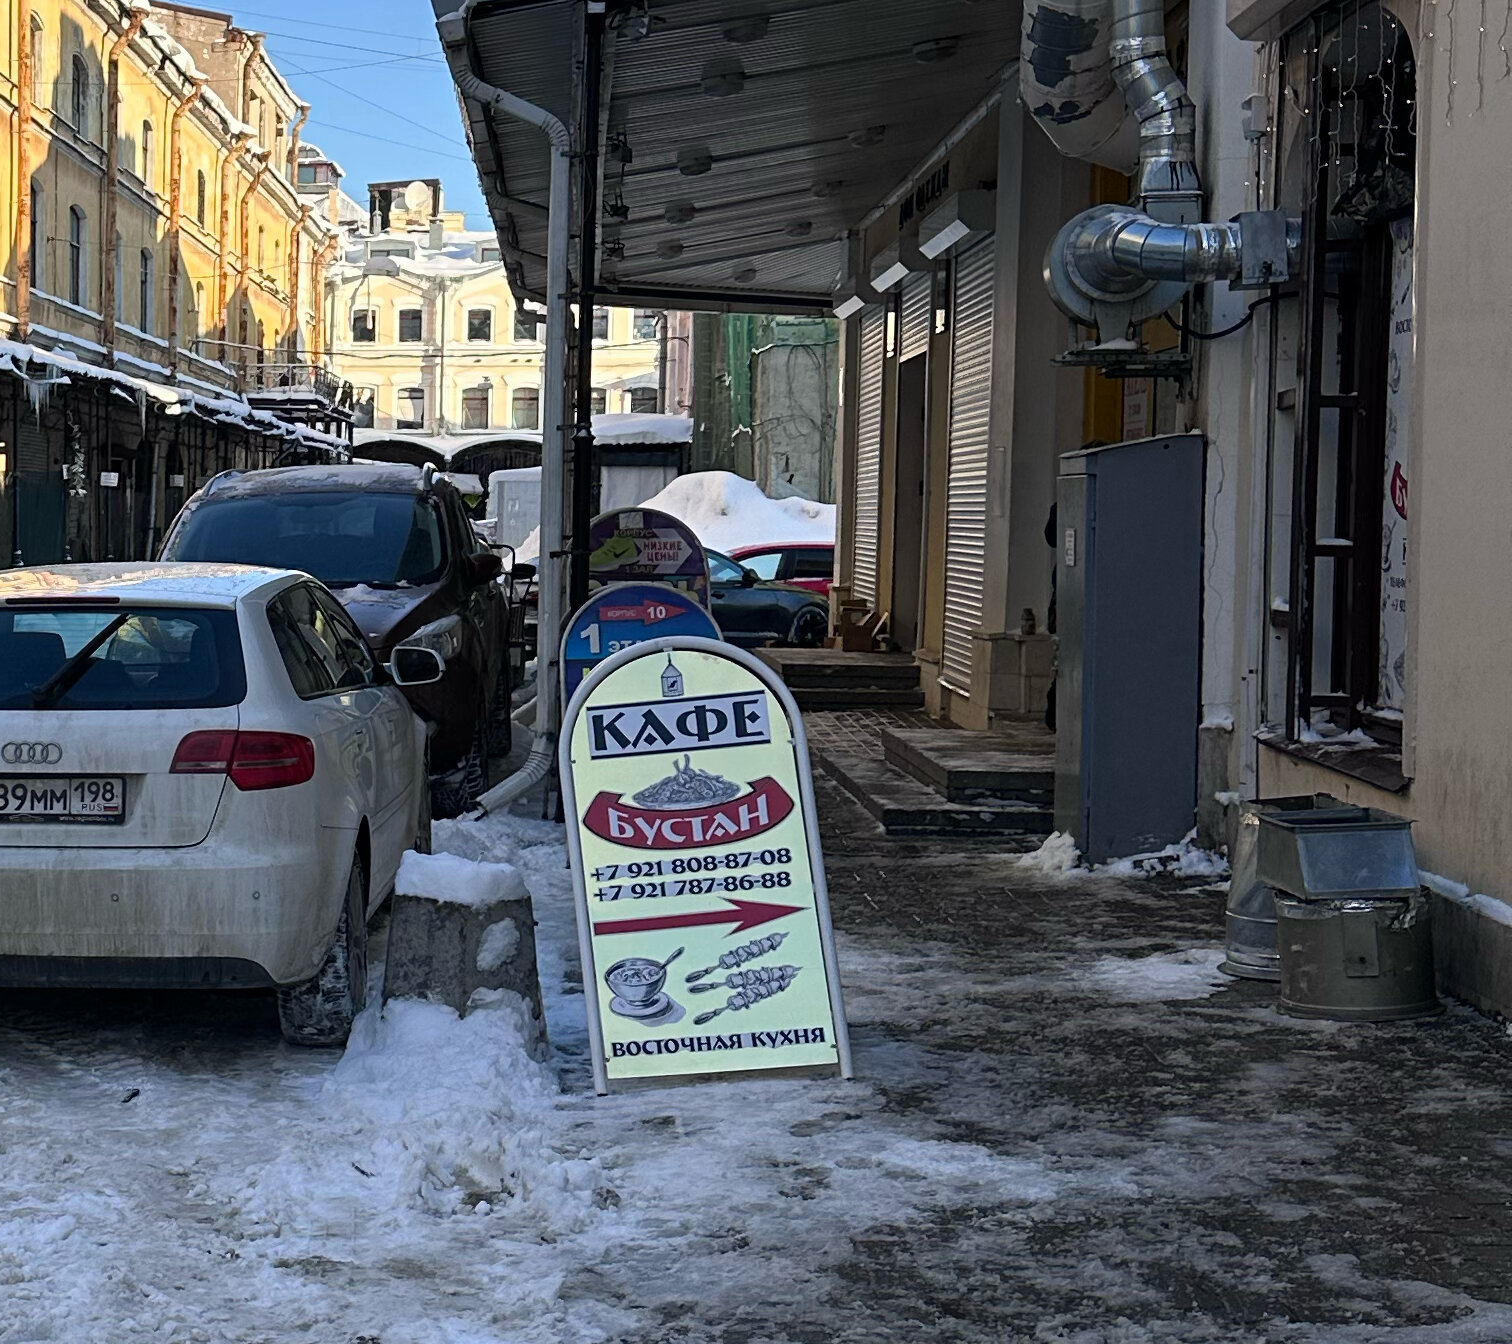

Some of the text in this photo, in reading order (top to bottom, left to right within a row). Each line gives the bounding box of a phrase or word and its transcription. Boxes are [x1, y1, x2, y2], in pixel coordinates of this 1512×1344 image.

[643, 540, 683, 552] НИЗКИЕ
[646, 606, 666, 619] 10
[580, 623, 600, 654] 1
[591, 698, 765, 751] КАФЕ
[73, 781, 115, 803] 198
[81, 803, 103, 812] RUS
[607, 793, 770, 845] БУСТАН
[591, 848, 792, 882] +7 921 808-87-08
[594, 871, 792, 902] +7 921 787-86-88
[611, 1027, 826, 1057] ВОСТОЧНАЯ КУХНЯ
